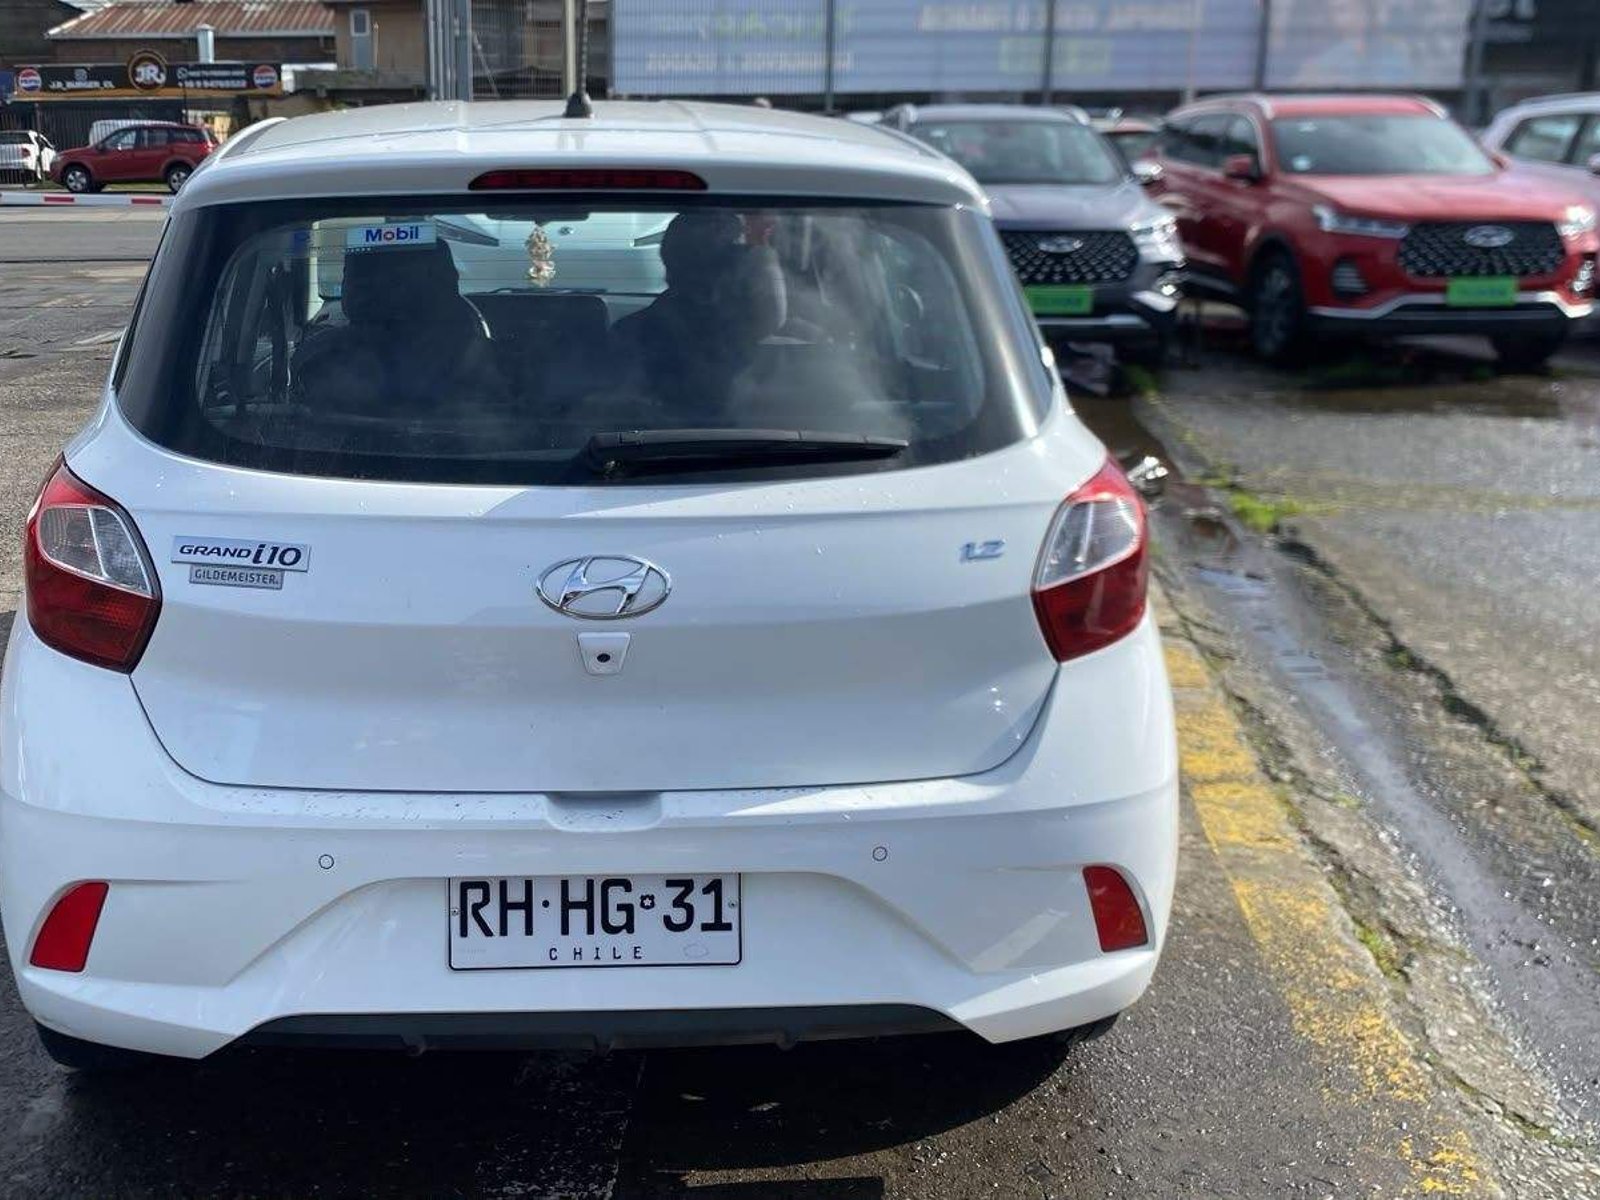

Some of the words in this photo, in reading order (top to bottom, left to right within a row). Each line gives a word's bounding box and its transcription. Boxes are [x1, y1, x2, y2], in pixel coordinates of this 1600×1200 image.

[365, 226, 420, 243] Mobil
[179, 544, 252, 559] GRAND
[252, 543, 302, 566] i10
[195, 569, 280, 585] GILDEMEISTER
[548, 945, 643, 961] CHILE
